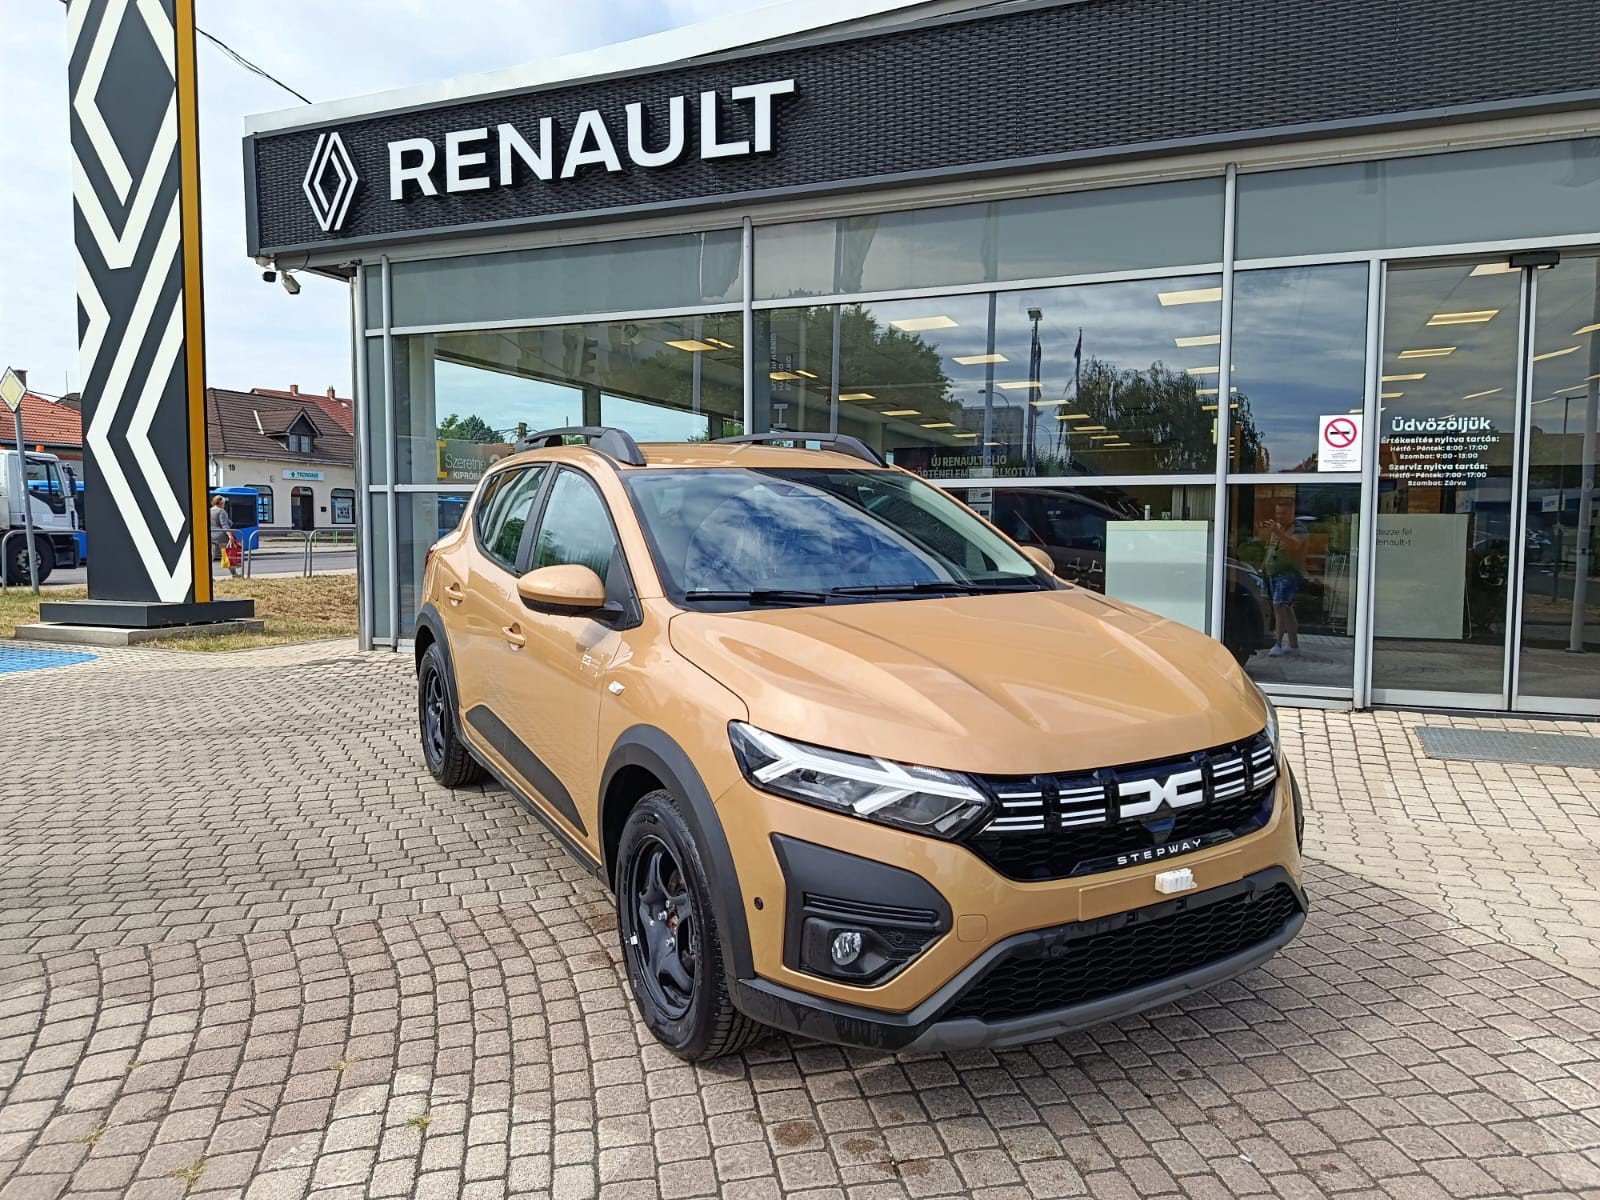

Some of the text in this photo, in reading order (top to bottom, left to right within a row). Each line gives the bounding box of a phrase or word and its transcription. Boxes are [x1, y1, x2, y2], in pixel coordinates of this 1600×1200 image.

[387, 78, 796, 201] RENAULT
[1391, 416, 1492, 433] Üdvözöljük
[1381, 434, 1500, 445] Értékesítés nyitva tartás:
[931, 454, 1007, 467] ÚJ RENAULT CLIO
[1388, 462, 1489, 472] Szerviz nyitva tartás:
[1402, 527, 1413, 536] fel
[1376, 538, 1411, 546] enault-t
[1117, 839, 1201, 865] STEPWAY
